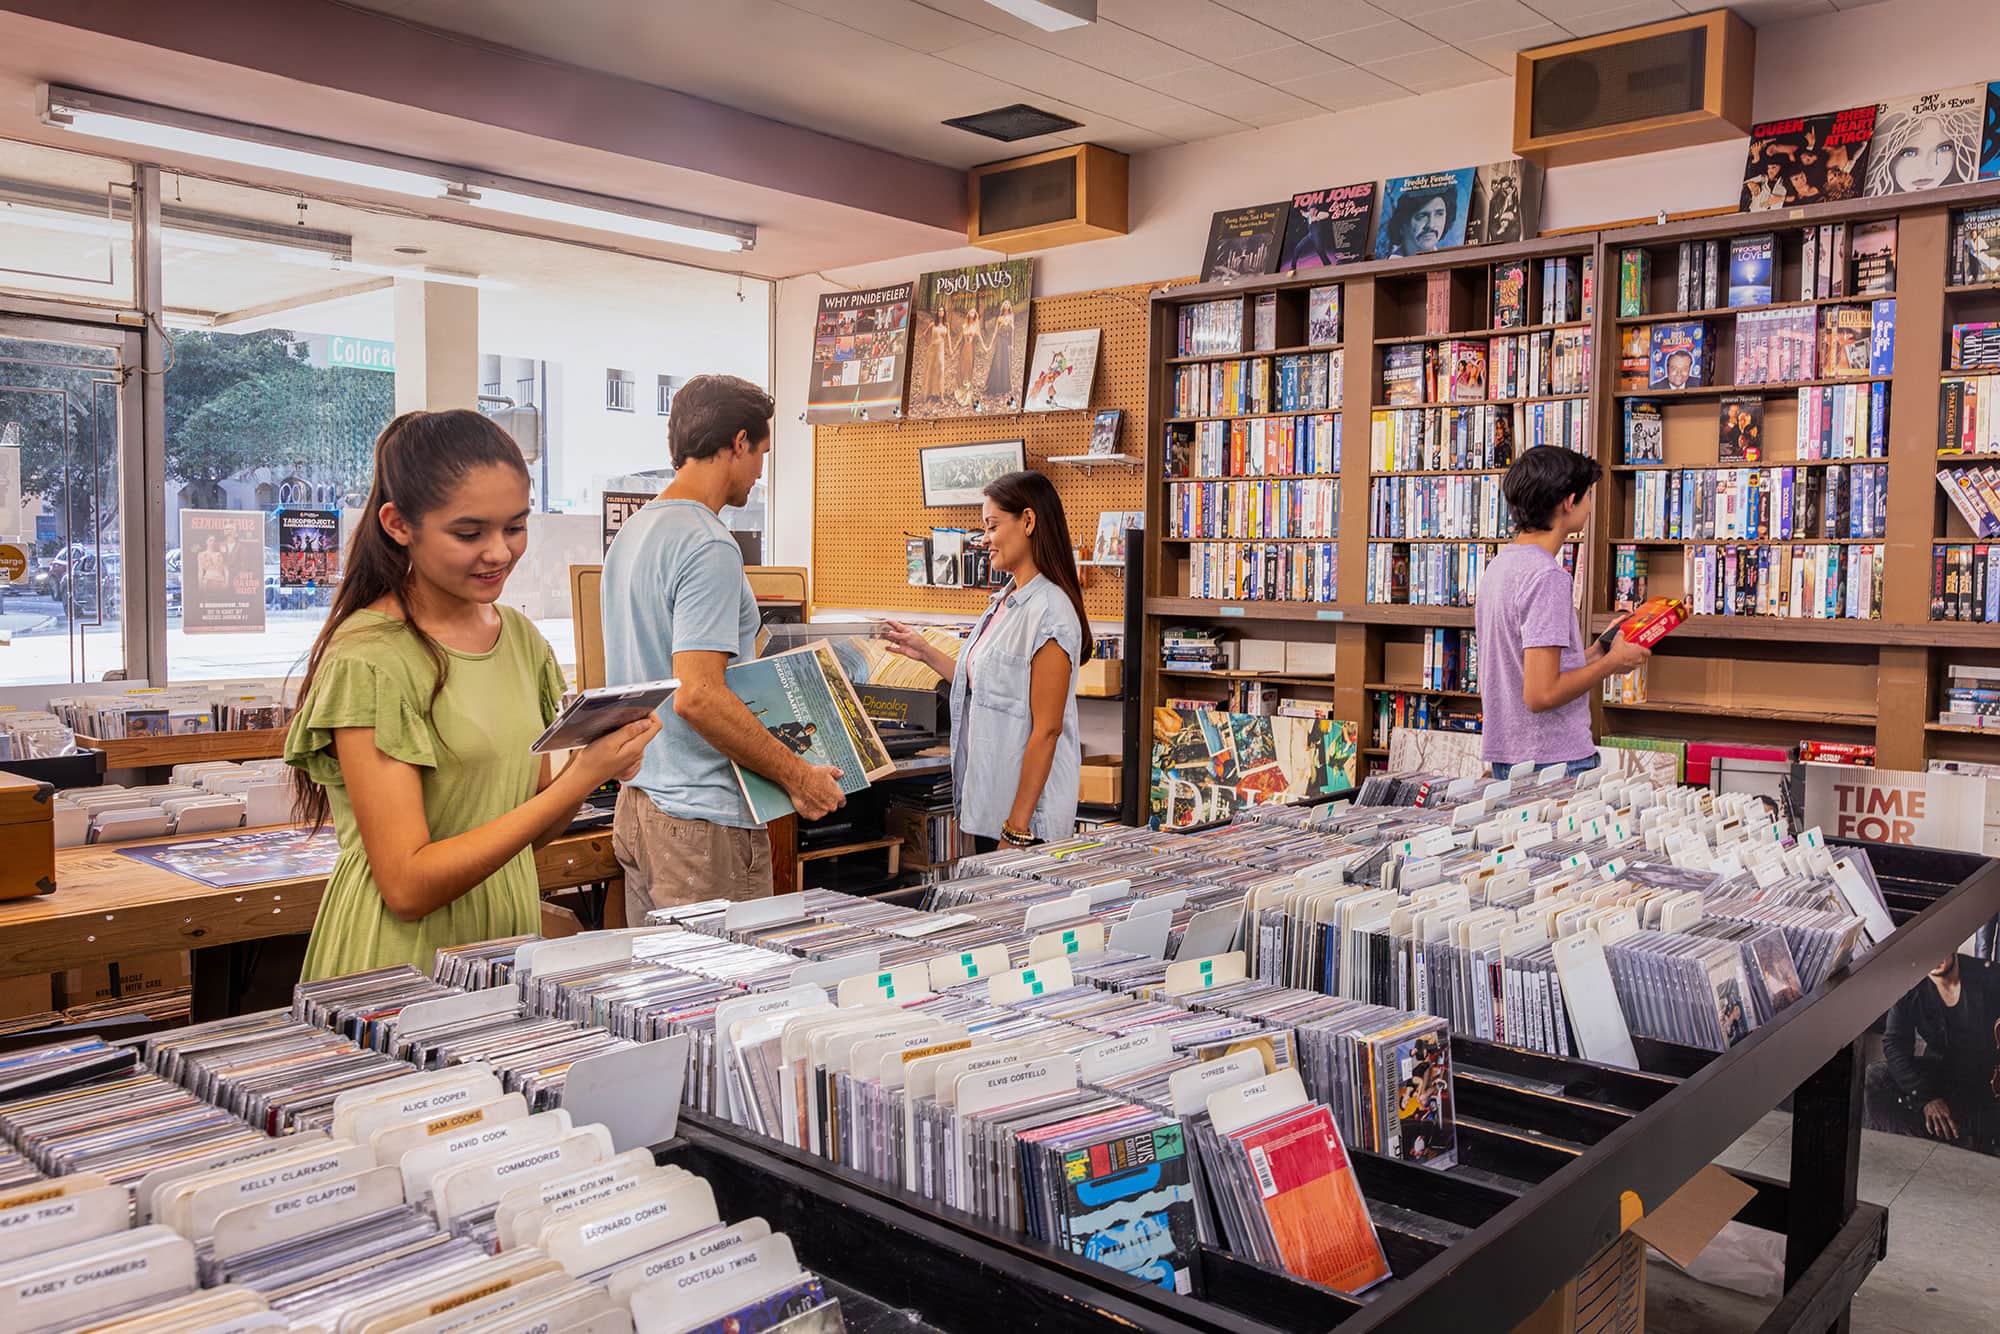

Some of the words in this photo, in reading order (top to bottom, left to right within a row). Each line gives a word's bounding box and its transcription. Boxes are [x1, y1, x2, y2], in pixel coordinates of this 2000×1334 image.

[1912, 101, 1946, 114] Lady's
[1948, 96, 1975, 108] Eyes
[1921, 93, 1940, 105] My
[1837, 106, 1875, 122] SHEER
[1754, 119, 1805, 138] QUEEN
[1832, 120, 1874, 134] HEART
[1824, 130, 1872, 147] ATTACK
[1404, 177, 1428, 188] Freddy
[1430, 173, 1456, 184] Fender
[1294, 192, 1324, 208] TOM
[1326, 184, 1373, 203] JONES
[1738, 250, 1763, 261] LOVE
[825, 294, 849, 309] WHY
[1834, 784, 1926, 819] TIME
[1838, 814, 1916, 846] FOR
[759, 1000, 790, 1013] CURSIVE
[903, 1048, 931, 1061] JOHNNY
[933, 1041, 972, 1055] CRAWFORD
[905, 1037, 929, 1048] CREAM
[1105, 1041, 1130, 1056] VINTAGE
[1132, 1037, 1149, 1049] ROCK
[968, 1059, 1001, 1071] DEBORAH
[1201, 1066, 1225, 1080] CYPRESS
[1226, 1063, 1240, 1072] HILL
[988, 1076, 1008, 1088] ELVIS
[1010, 1068, 1047, 1083] COSTELLO
[1386, 1053, 1397, 1113] CRANBERRIES
[402, 1100, 429, 1113] ALICE
[432, 1091, 467, 1107] COOPER
[428, 1120, 448, 1133] SAM
[451, 1111, 482, 1126] COOKE
[1388, 1115, 1398, 1131] THE
[450, 1138, 478, 1152] DAVID
[483, 1130, 508, 1144] COOK
[1135, 1132, 1156, 1164] ELVIS
[1124, 1137, 1138, 1168] COSTELLO
[497, 1150, 561, 1176] COMMODORES
[240, 1175, 278, 1192] KELLY
[281, 1159, 339, 1183] CLARKSON
[276, 1199, 302, 1214] ERIC
[306, 1184, 356, 1206] CLAPTON
[543, 1187, 576, 1205] SHAWN
[580, 1174, 614, 1193] COLVIN
[37, 1203, 75, 1219] TRICK
[585, 1217, 632, 1240] LEONARD
[635, 1203, 667, 1222] COHEN
[646, 1256, 685, 1277] COHEED
[689, 1252, 697, 1262] &
[700, 1235, 743, 1257] CAMBRIA
[20, 1279, 67, 1298] KASEY
[74, 1258, 148, 1286] CHAMBERS
[678, 1265, 725, 1288] COCTEAU
[729, 1252, 758, 1270] TWINS
